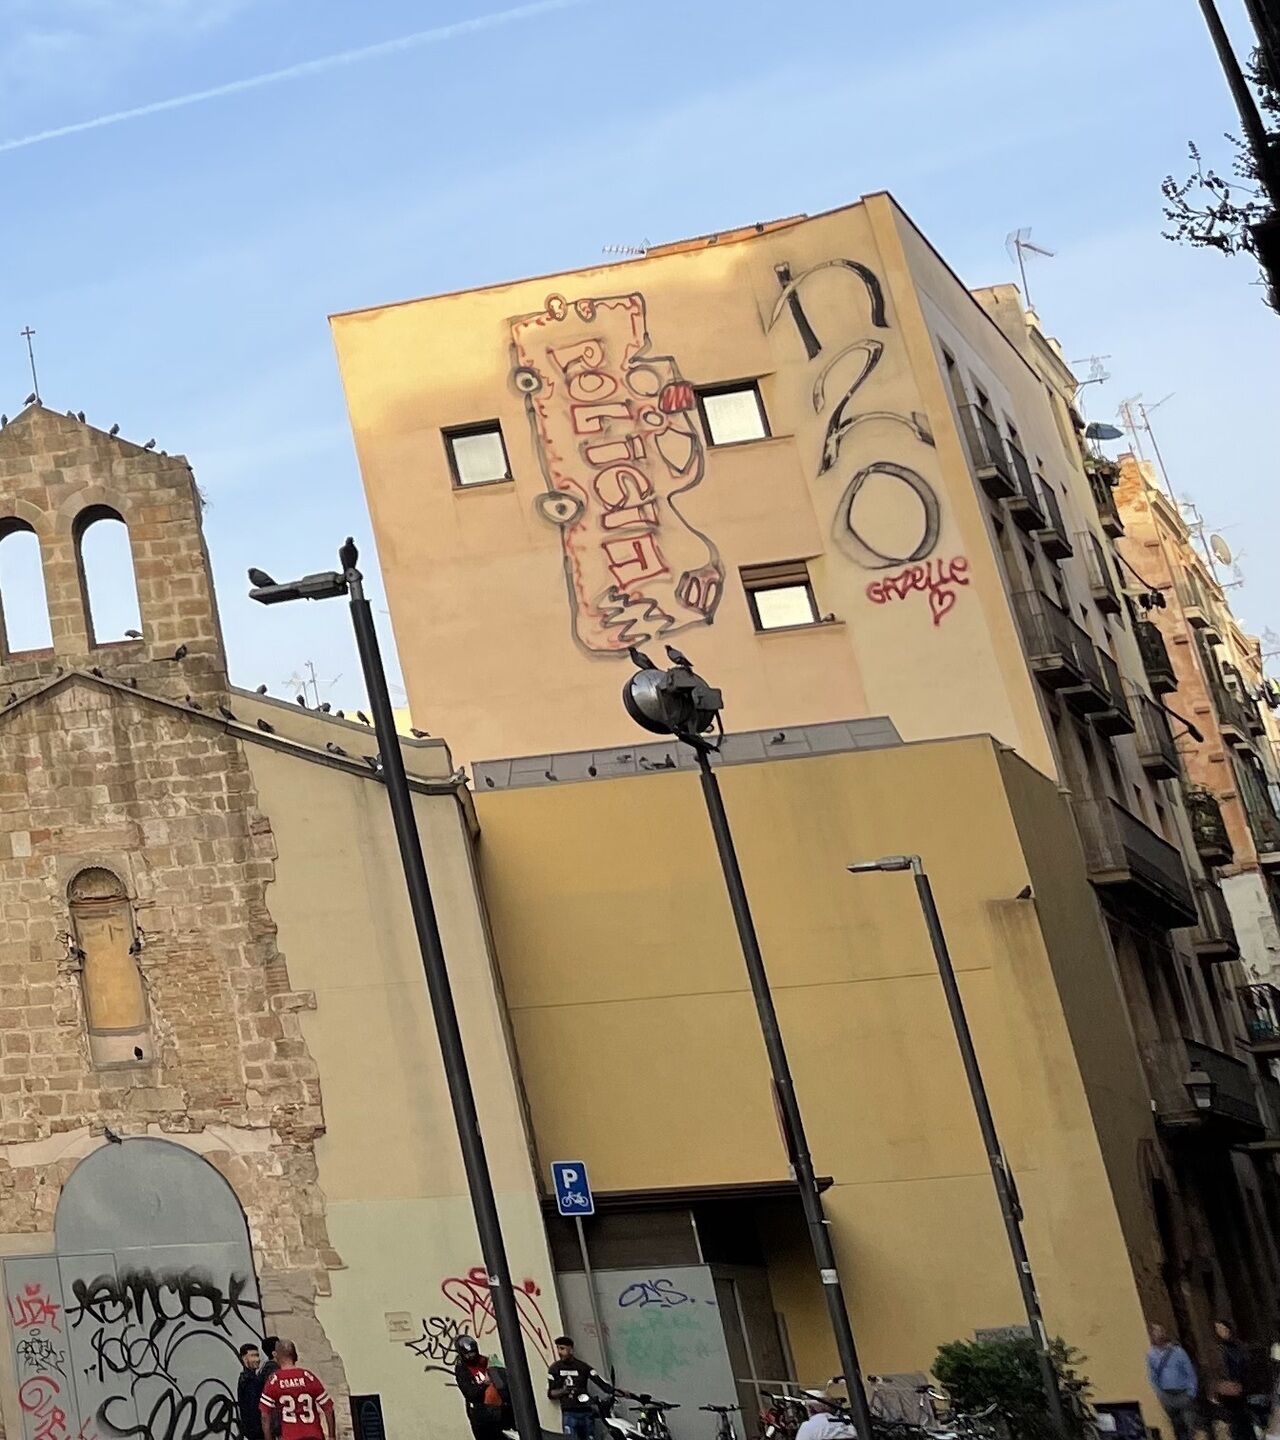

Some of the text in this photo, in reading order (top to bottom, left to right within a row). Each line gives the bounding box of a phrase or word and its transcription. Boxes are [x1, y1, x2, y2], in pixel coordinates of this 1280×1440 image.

[561, 1168, 579, 1189] P
[279, 1377, 306, 1389] COACH
[279, 1393, 315, 1424] 23
